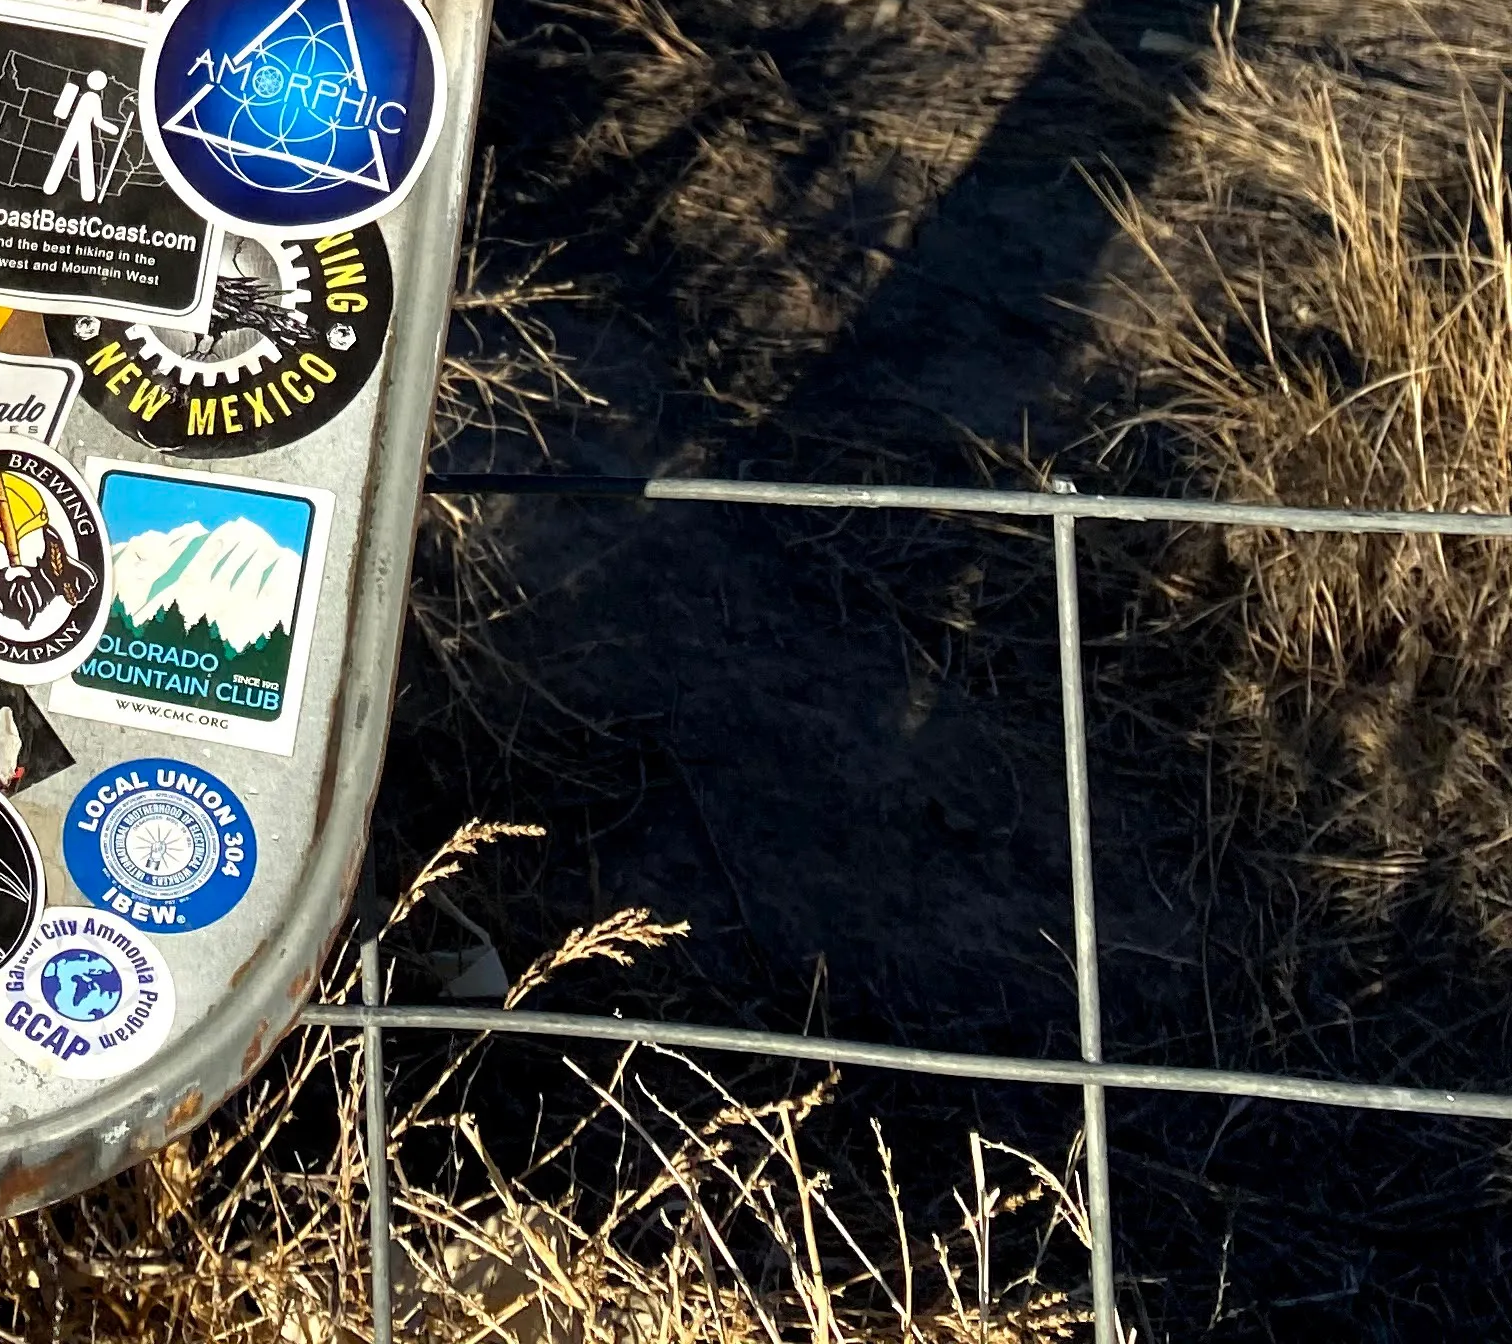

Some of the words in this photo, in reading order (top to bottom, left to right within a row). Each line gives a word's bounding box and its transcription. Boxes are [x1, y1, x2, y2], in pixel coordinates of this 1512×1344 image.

[188, 48, 407, 135] AMORPHIC
[17, 238, 38, 251] the
[42, 240, 71, 255] best
[75, 245, 115, 262] hiking
[118, 249, 130, 261] in
[135, 253, 156, 266] the
[33, 260, 57, 272] and
[61, 263, 121, 279] Mountain
[126, 270, 159, 285] West
[85, 340, 171, 422] NEW
[187, 351, 338, 436] MEXICO
[7, 452, 95, 538] BREWING
[96, 634, 219, 673] OLORADO
[77, 658, 212, 698] MOUNTAIN
[215, 682, 281, 711] CLUB
[232, 674, 260, 688] SINCE
[115, 698, 229, 730] WWW.CMC.ORG
[77, 771, 149, 832] LOCAL
[156, 768, 237, 827] UNION
[221, 831, 245, 878] 304
[41, 919, 77, 940] City
[101, 886, 177, 925] IBEW
[83, 917, 154, 984] Ammonia
[4, 1000, 91, 1062] GCAP
[98, 989, 159, 1050] Program
